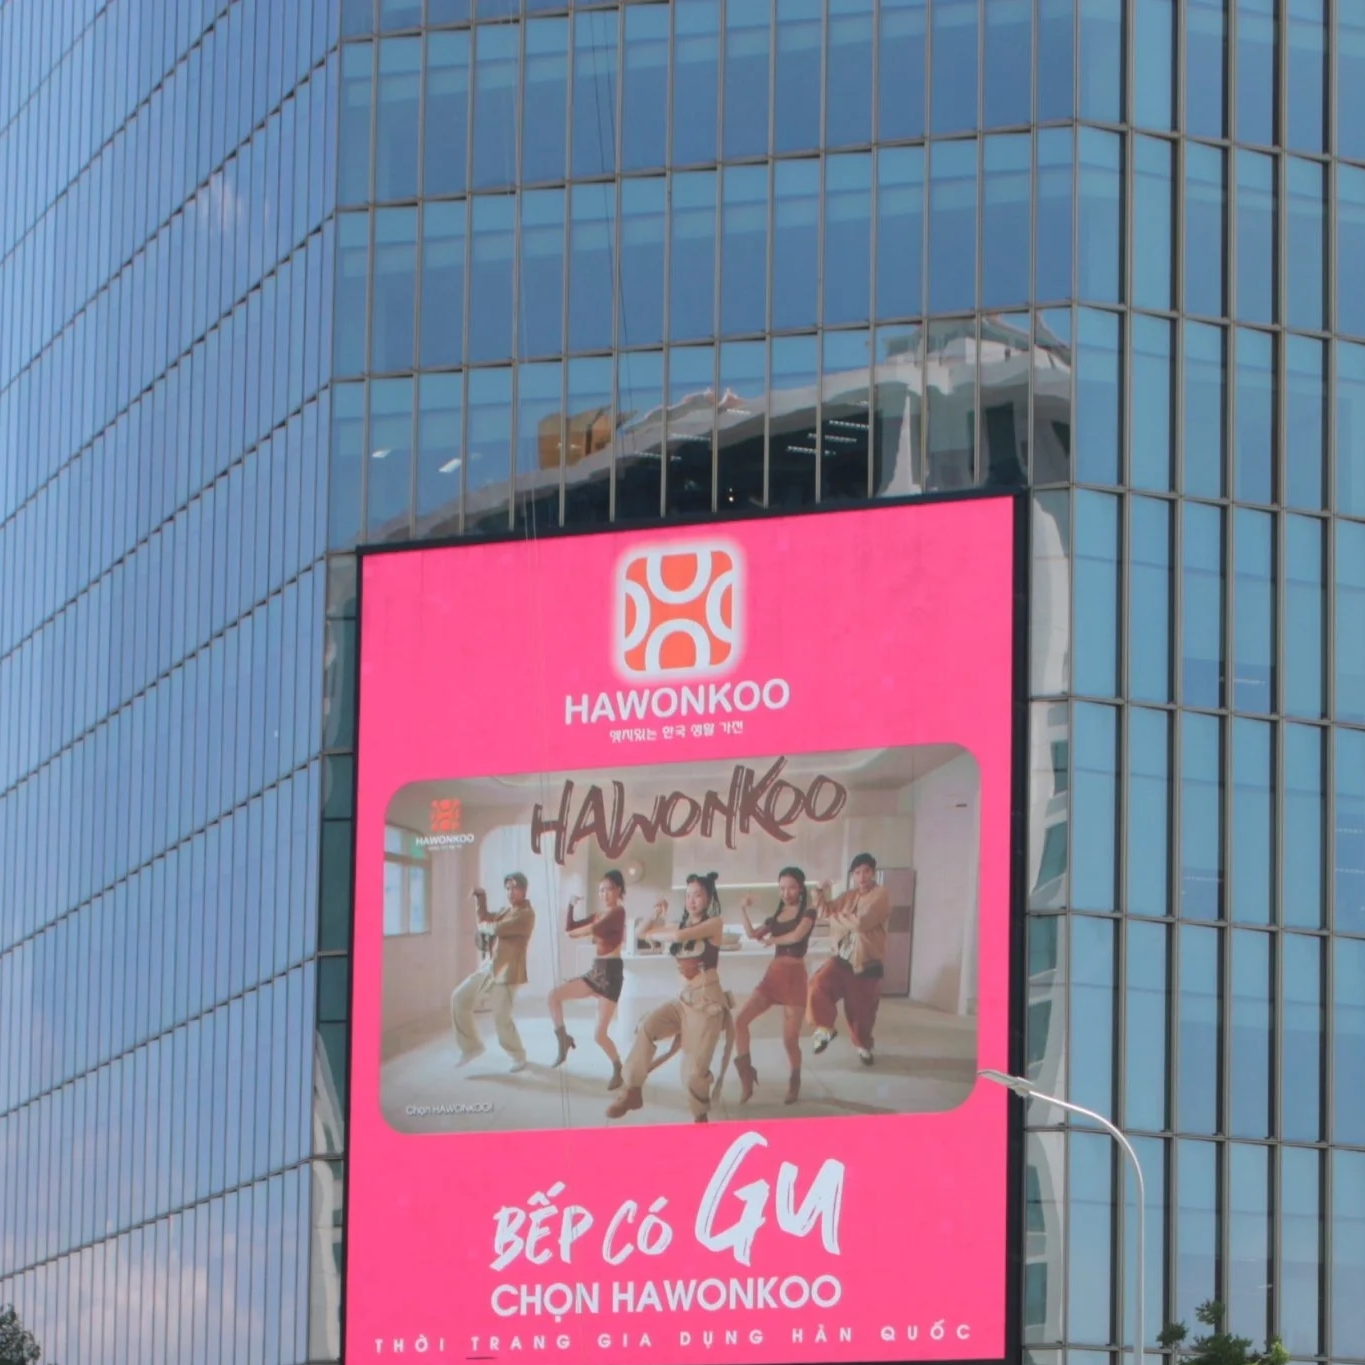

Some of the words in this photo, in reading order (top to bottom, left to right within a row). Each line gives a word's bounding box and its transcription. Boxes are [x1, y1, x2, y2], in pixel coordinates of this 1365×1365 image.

[565, 678, 790, 725] HAWONKOO
[490, 1181, 593, 1271] BẾP
[602, 1195, 673, 1267] CÓ
[490, 1282, 600, 1323] CHỌN
[612, 1274, 842, 1314] HAWONKOO
[471, 1331, 571, 1351] TRANG
[597, 1330, 653, 1349] GIA
[679, 1329, 765, 1349] DỤNG
[791, 1322, 853, 1344] HÀN
[879, 1319, 972, 1342] QUỐC
